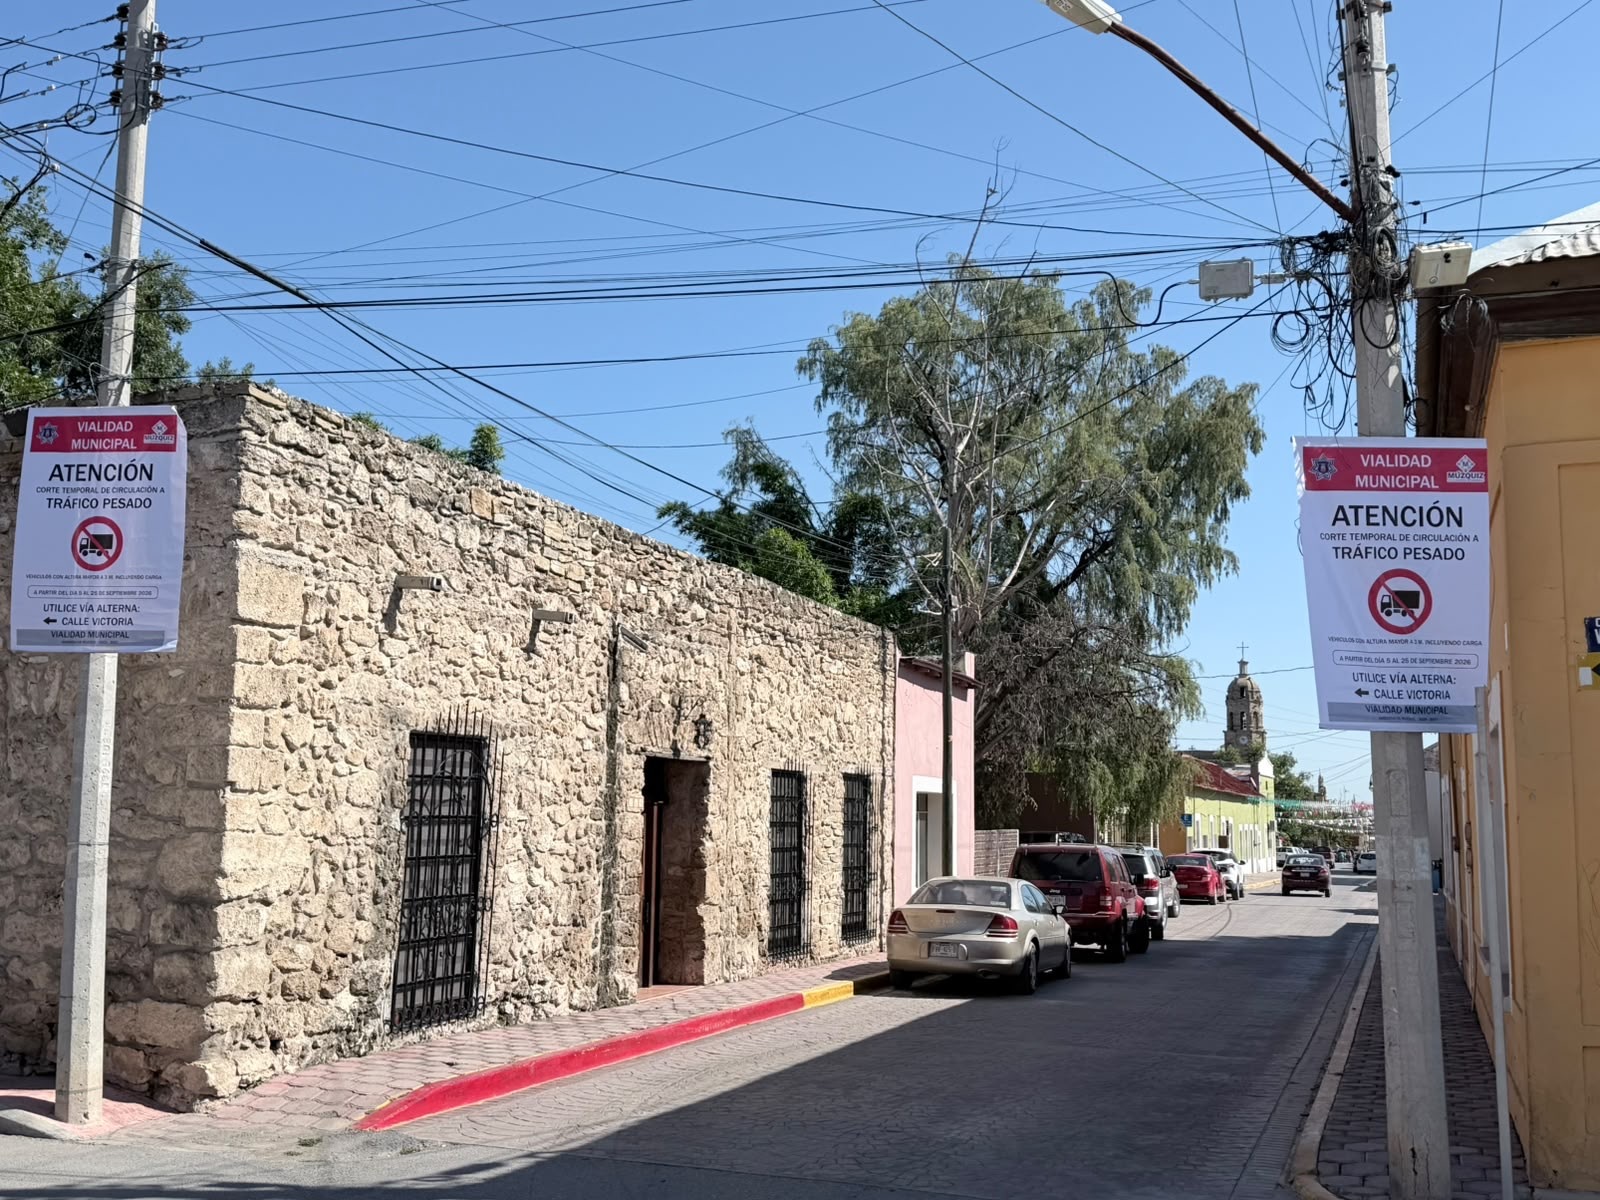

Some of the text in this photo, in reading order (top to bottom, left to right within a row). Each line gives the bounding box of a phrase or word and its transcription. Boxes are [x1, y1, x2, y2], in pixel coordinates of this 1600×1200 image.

[77, 421, 134, 433] VIALIDAD
[71, 438, 137, 450] MUNICIPAL
[1360, 454, 1432, 468] VIALIDAD
[48, 458, 154, 482] ATENCIÓN
[1355, 475, 1439, 488] MUNICIPAL
[112, 486, 158, 494] CIRCULACIÓN
[46, 496, 152, 510] TRÁFICO PESADO
[1331, 500, 1463, 528] ATENCIÓN
[1320, 532, 1347, 541] CORTE
[1350, 533, 1397, 541] TEMPORAL
[1400, 534, 1410, 542] DE
[1412, 533, 1471, 542] CIRCULACIÓN
[1332, 543, 1465, 560] TRÁFICO PESADO
[43, 602, 140, 613] UTILICE VÍA ALTERNA:
[61, 617, 134, 626] CALLE VICTORIA
[51, 630, 130, 639] VIALIDAD MUNICIPAL
[1352, 671, 1456, 685] UTILICE VÍA ALTERNA:
[1374, 688, 1451, 700] CALLE VICTORIA
[1365, 705, 1448, 715] VIALIDAD MUNICIPAL
